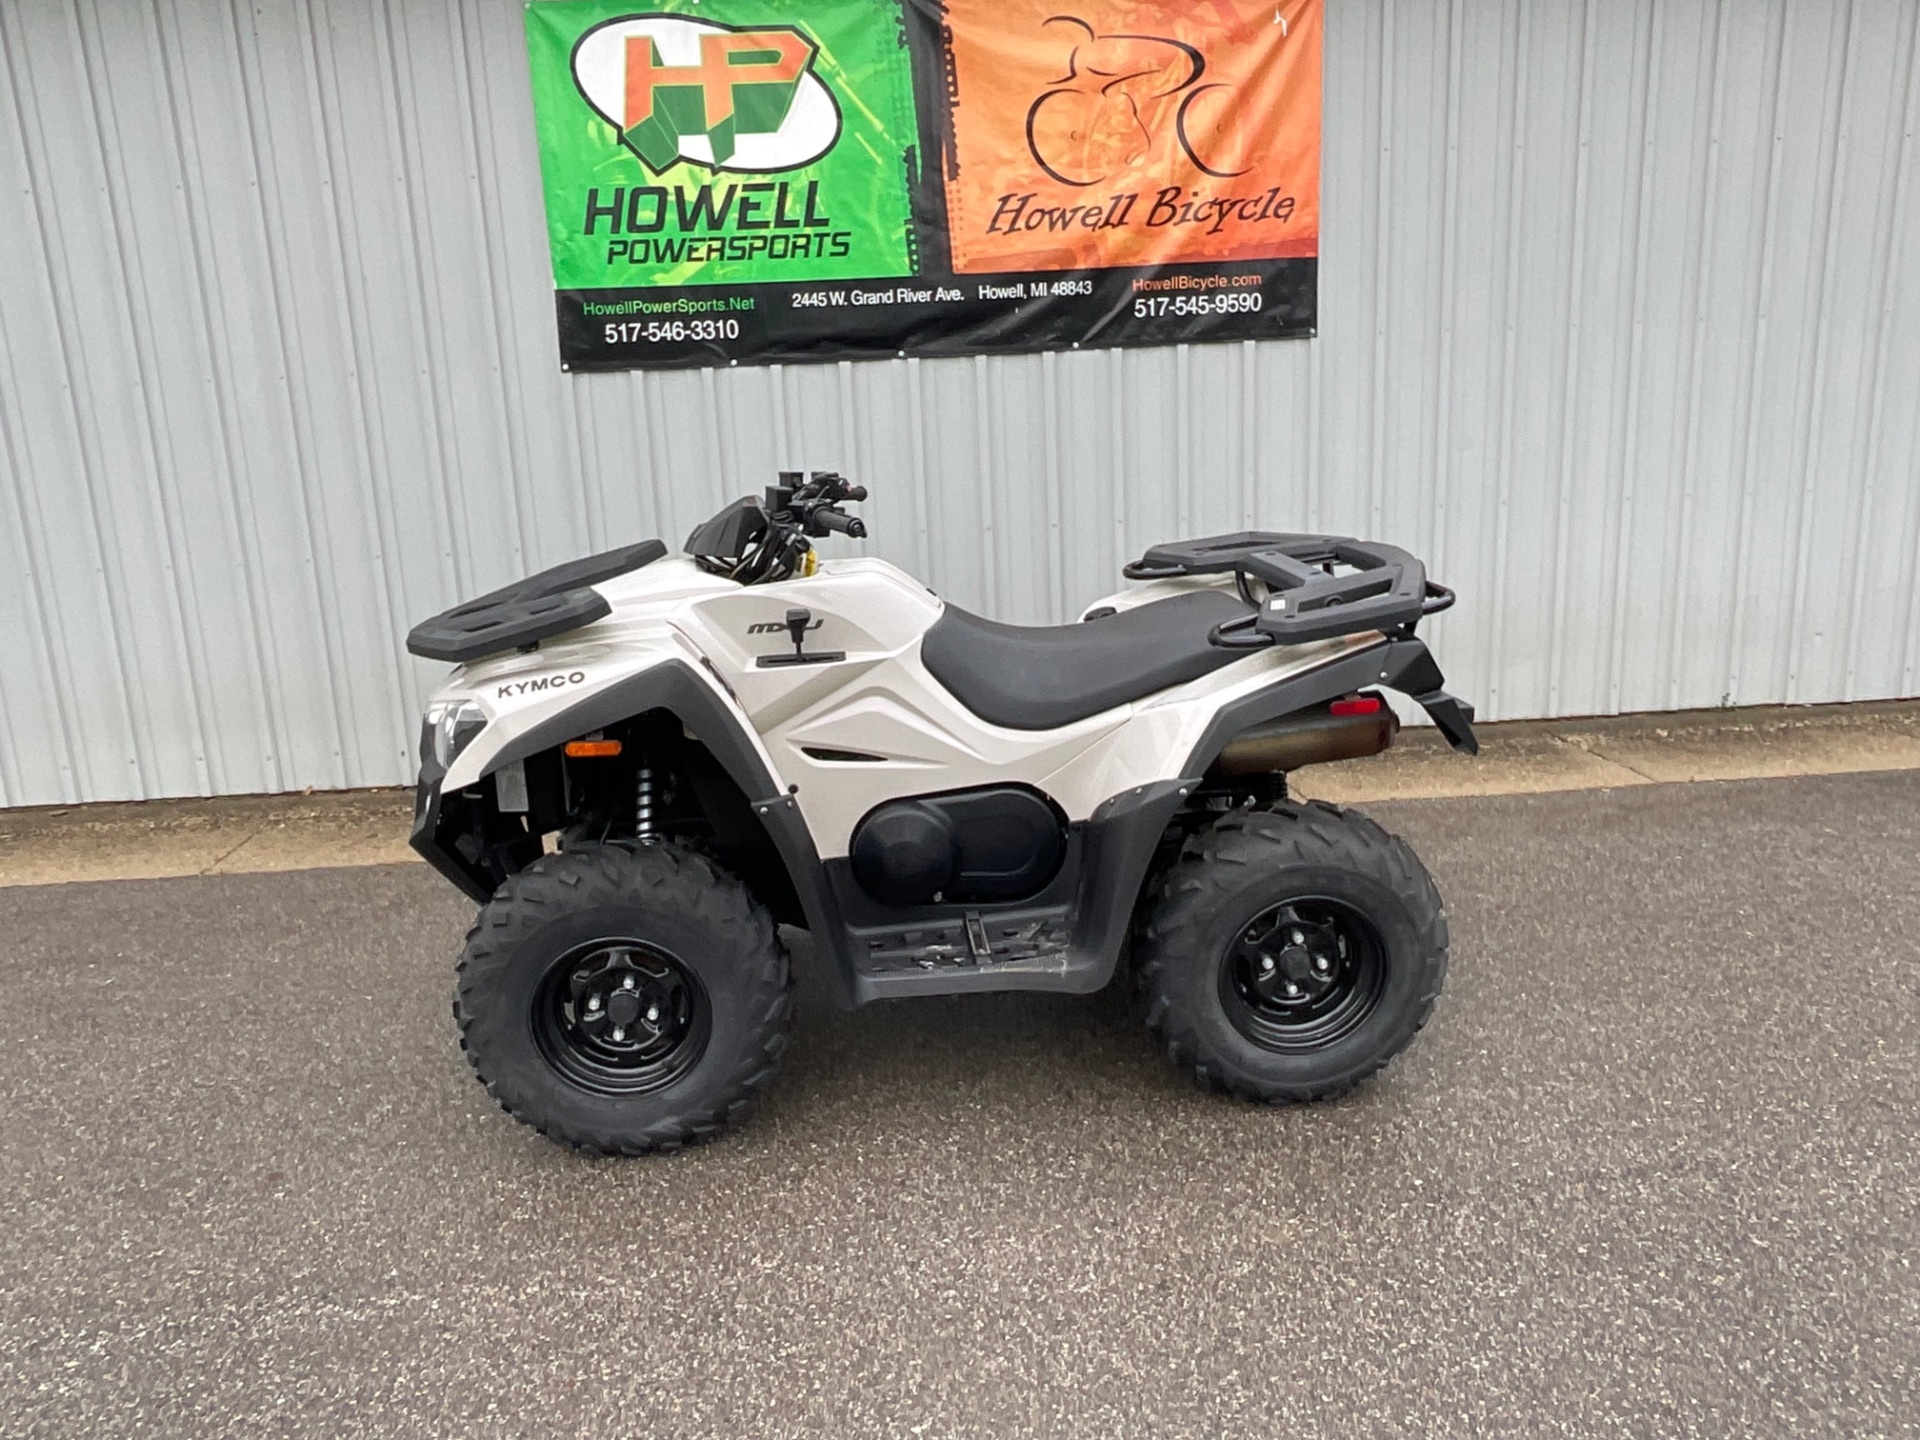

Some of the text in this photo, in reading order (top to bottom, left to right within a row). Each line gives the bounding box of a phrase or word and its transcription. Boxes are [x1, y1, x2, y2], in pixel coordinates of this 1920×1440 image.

[624, 30, 812, 134] HP
[583, 180, 830, 236] HOWELL
[986, 186, 1296, 236] Howell Bicycle
[606, 232, 852, 265] POWERSPORTS
[978, 280, 1093, 300] Howell, MI 48843
[1131, 274, 1263, 292] HowellBicycle.com
[582, 296, 756, 316] HowellPowerSports.Net
[791, 286, 965, 308] 2445 W. Grand River Ave.
[1133, 292, 1263, 318] 517-545-9590
[604, 319, 740, 344] 517-546-3310
[497, 671, 586, 699] KYMCO
